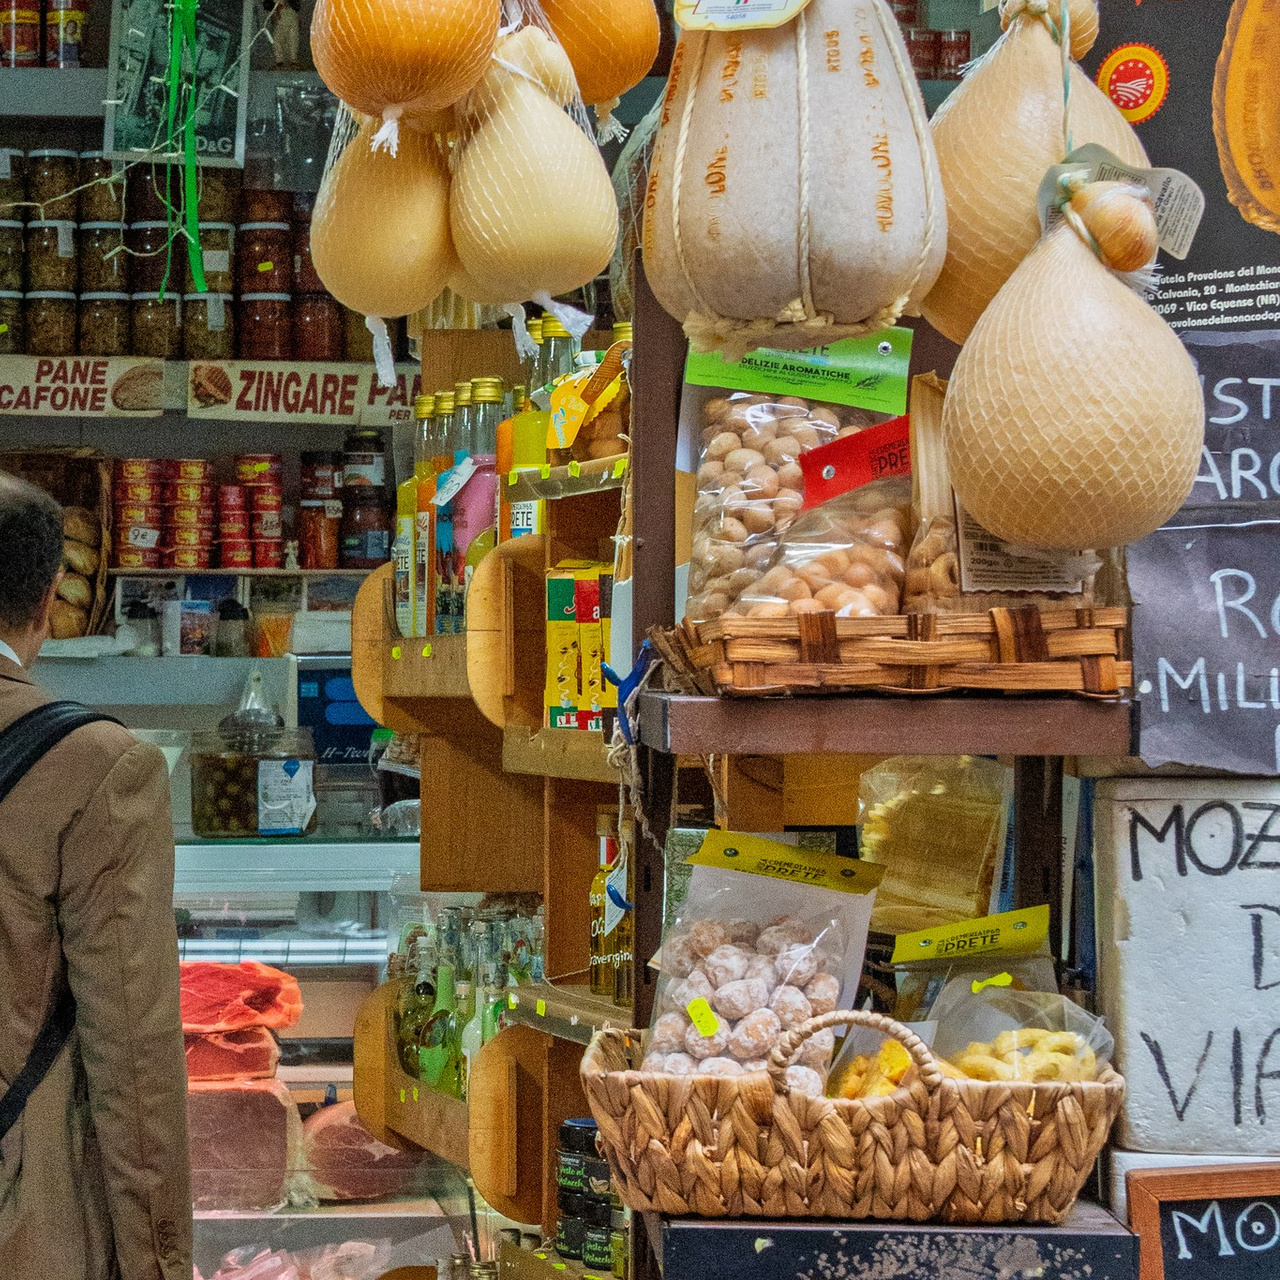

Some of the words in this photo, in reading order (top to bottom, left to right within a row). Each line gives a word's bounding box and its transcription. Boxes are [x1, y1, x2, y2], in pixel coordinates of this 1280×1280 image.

[195, 135, 233, 153] D&G
[1187, 269, 1236, 283] Provolone
[1237, 266, 1254, 277] del
[1203, 286, 1217, 296] 20
[1186, 301, 1208, 312] Vico
[1210, 297, 1254, 311] Equense
[35, 360, 109, 385] PANE
[741, 357, 780, 369] DELIZIE
[782, 362, 851, 379] AROMATICHE
[235, 370, 360, 415] ZINGARE
[945, 933, 1001, 953] PRETE
